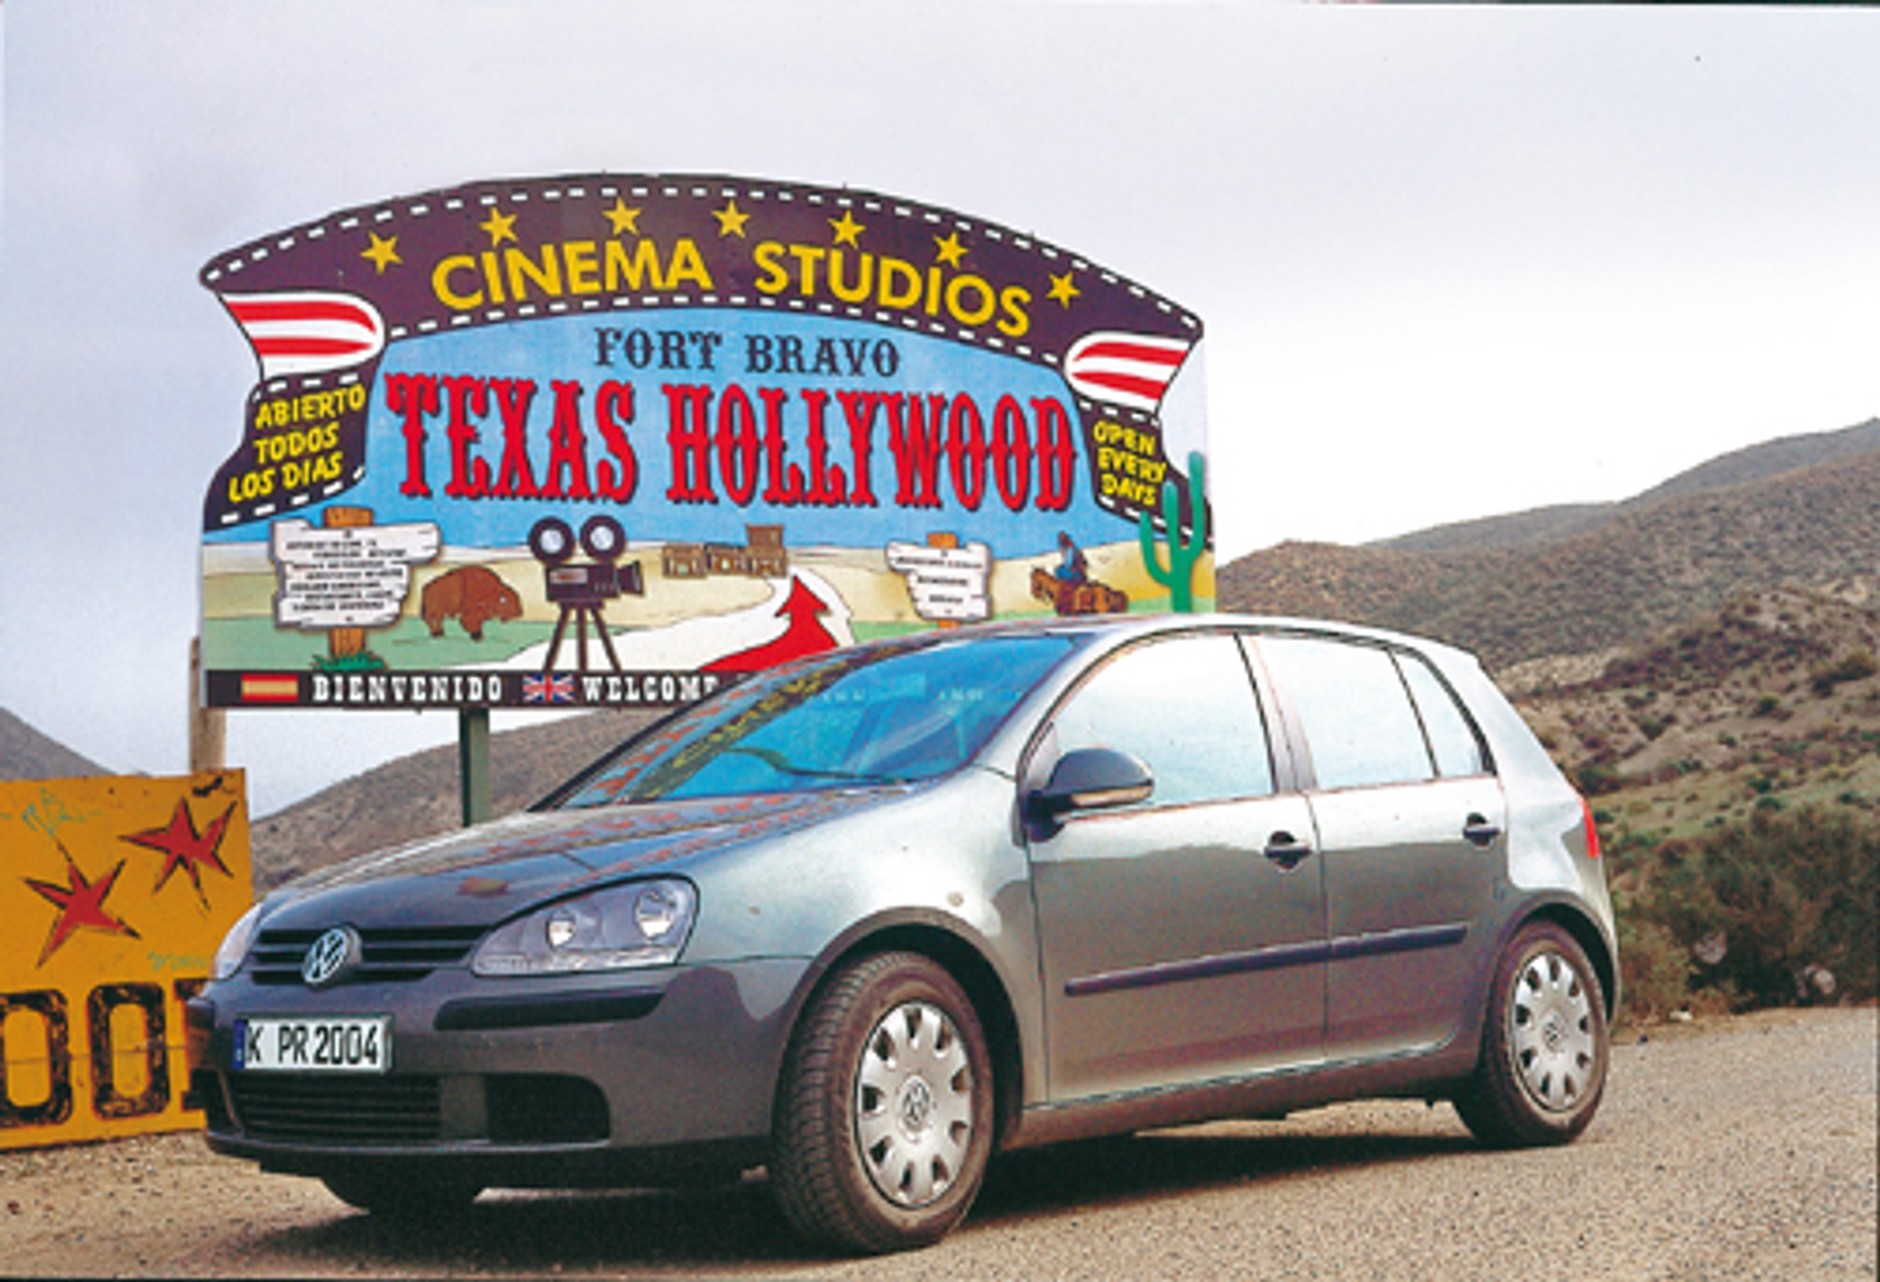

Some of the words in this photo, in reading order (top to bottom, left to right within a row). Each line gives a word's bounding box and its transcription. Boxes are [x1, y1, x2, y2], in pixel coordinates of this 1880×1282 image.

[432, 239, 714, 310] CINEMA
[753, 241, 1031, 337] STUDIOS
[595, 327, 723, 371] FORT
[745, 334, 900, 377] BRAVO
[255, 383, 366, 429] ABIERTO
[253, 421, 340, 464] TODOS
[384, 372, 640, 505] TEXAS
[662, 382, 1077, 512] HOLLYWOOD
[1094, 421, 1156, 456] OPEN
[229, 468, 276, 503] LOS
[281, 451, 343, 490] DIAS
[1098, 447, 1167, 482] EVERY
[1102, 473, 1156, 506] DAYS
[312, 675, 503, 702] BIENVENIDO
